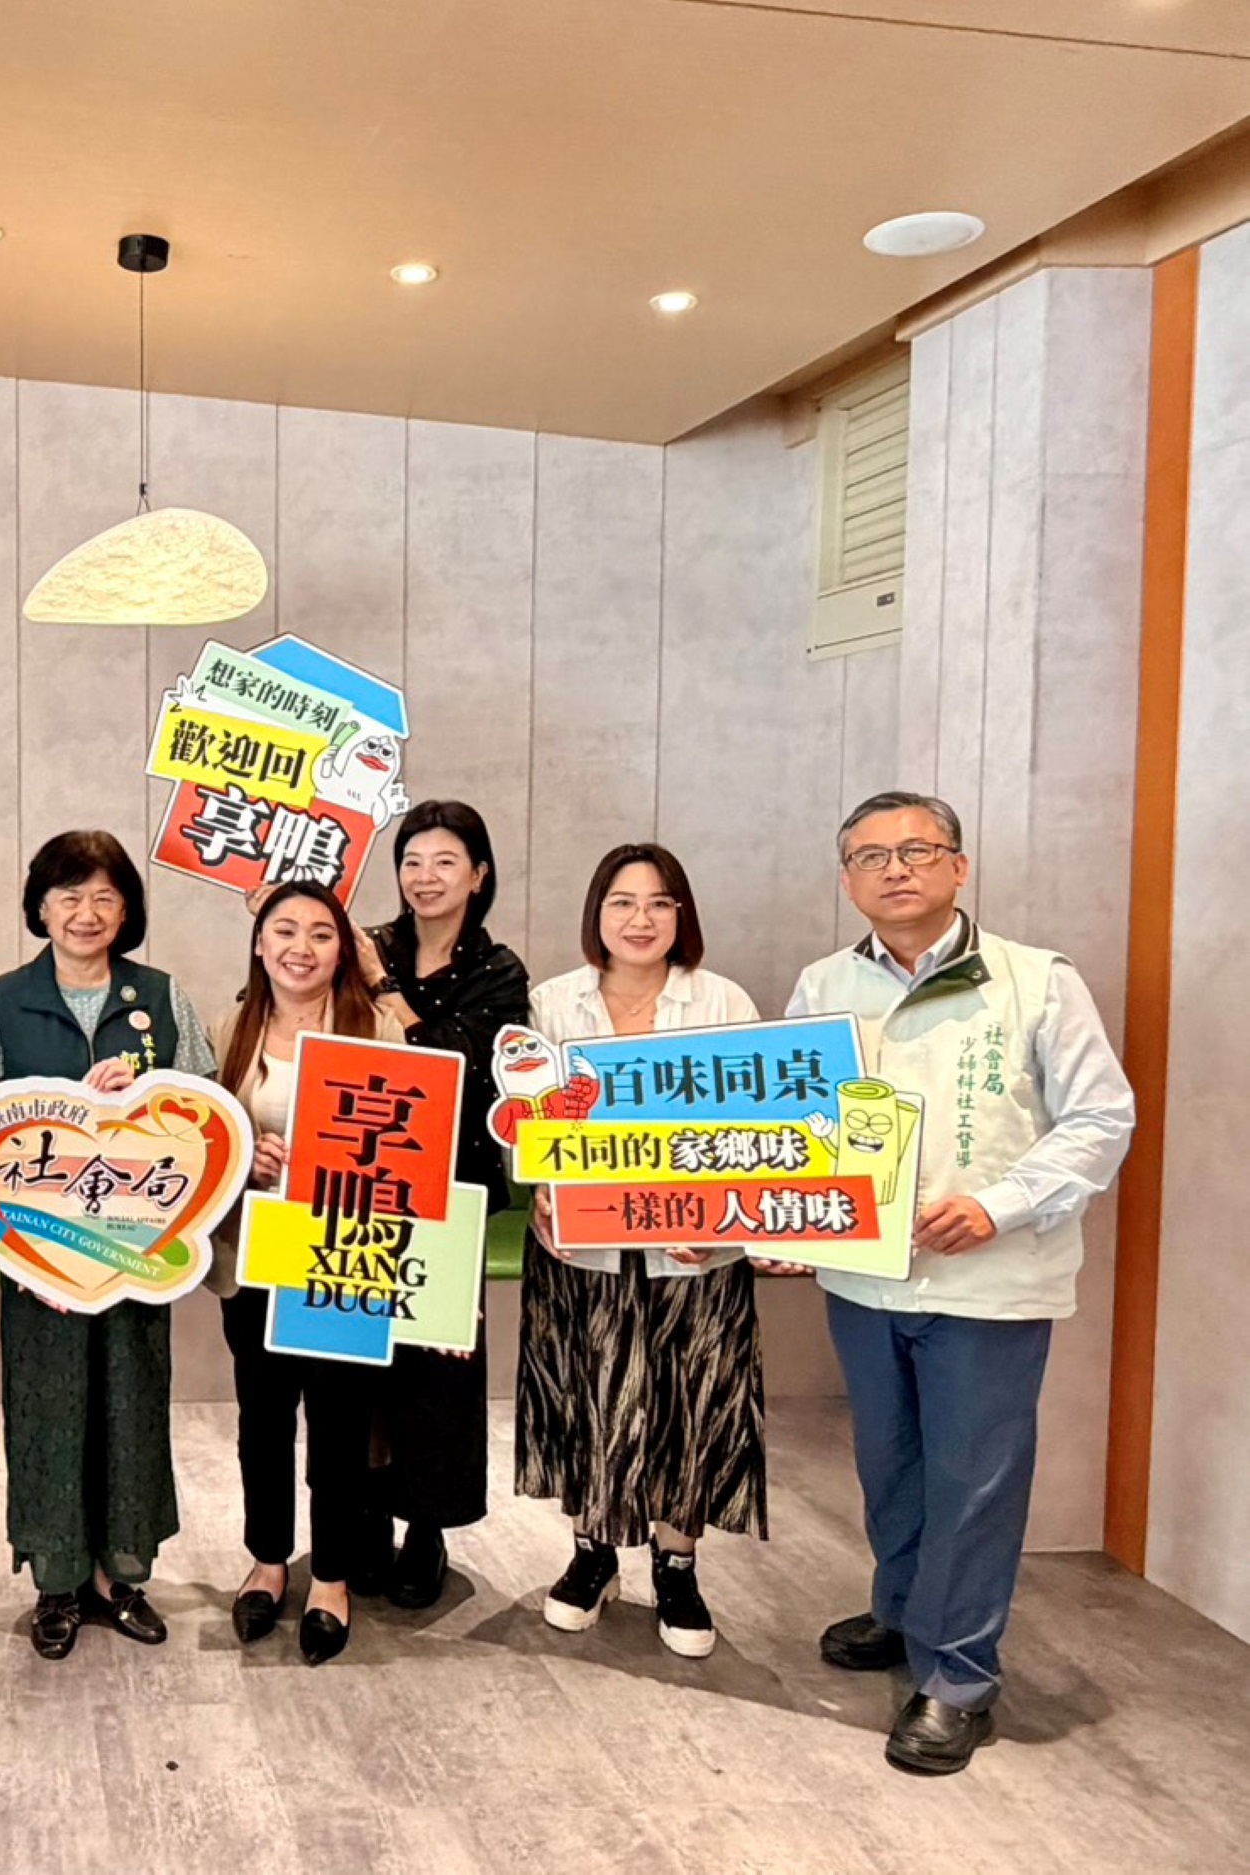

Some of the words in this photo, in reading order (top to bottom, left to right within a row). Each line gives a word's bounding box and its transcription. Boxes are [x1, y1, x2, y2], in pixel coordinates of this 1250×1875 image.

[205, 659, 340, 732] 想家的時刻
[169, 719, 306, 788] 歡迎回
[181, 783, 350, 887] 享鴨
[597, 1049, 831, 1107] 百味同桌
[980, 1024, 1004, 1095] 社會局
[312, 1074, 427, 1256] 享鴨
[2, 1209, 51, 1231] TAINAN
[49, 1222, 78, 1243] CITY
[78, 1235, 161, 1278] GOVERNMENT
[307, 1244, 428, 1288] XIANG
[303, 1278, 416, 1320] DUCK
